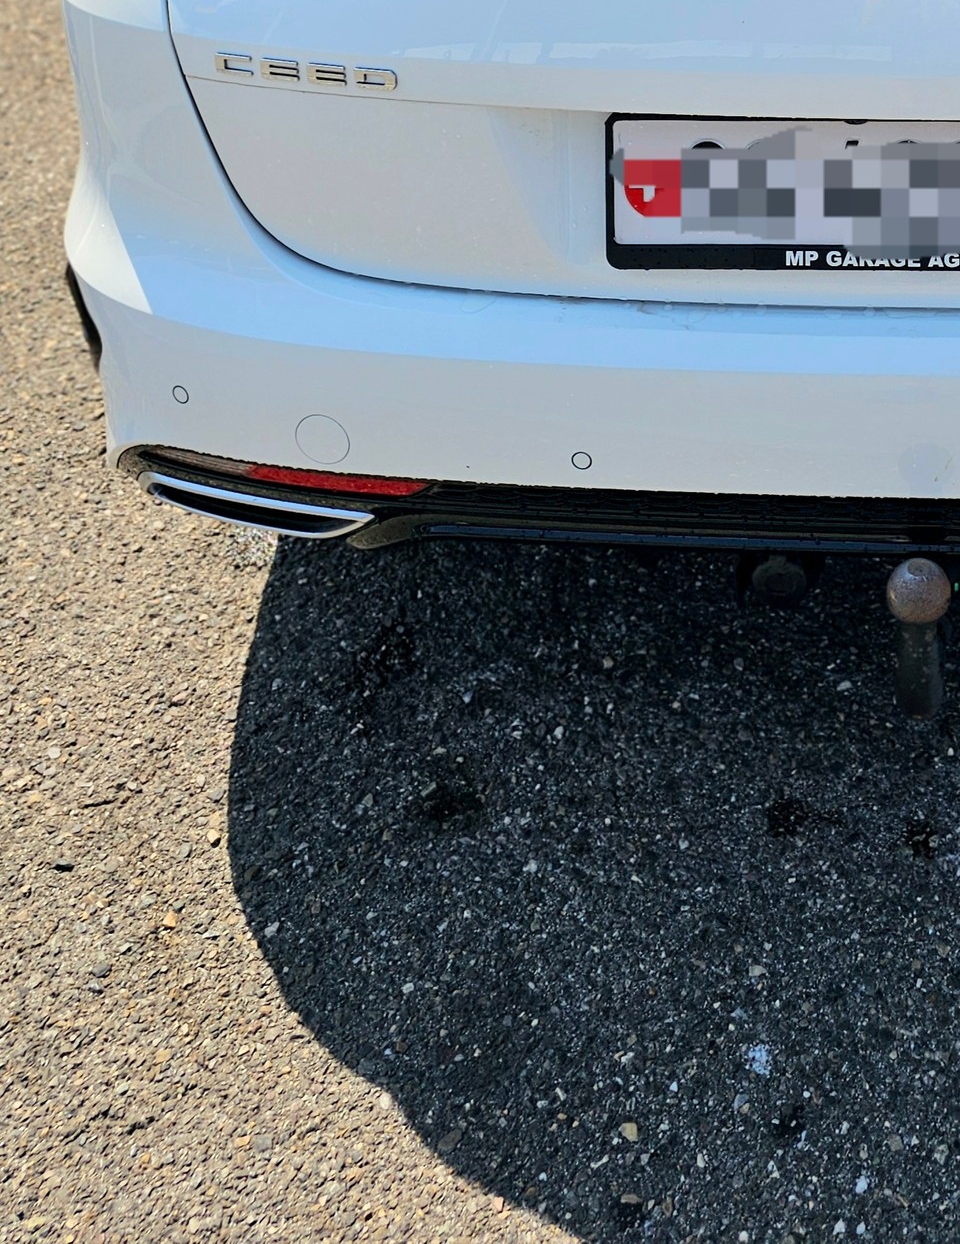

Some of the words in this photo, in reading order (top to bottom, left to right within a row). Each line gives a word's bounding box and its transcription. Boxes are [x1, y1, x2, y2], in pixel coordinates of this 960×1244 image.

[215, 52, 398, 92] CEED
[785, 251, 818, 267] MP
[928, 252, 960, 268] AG
